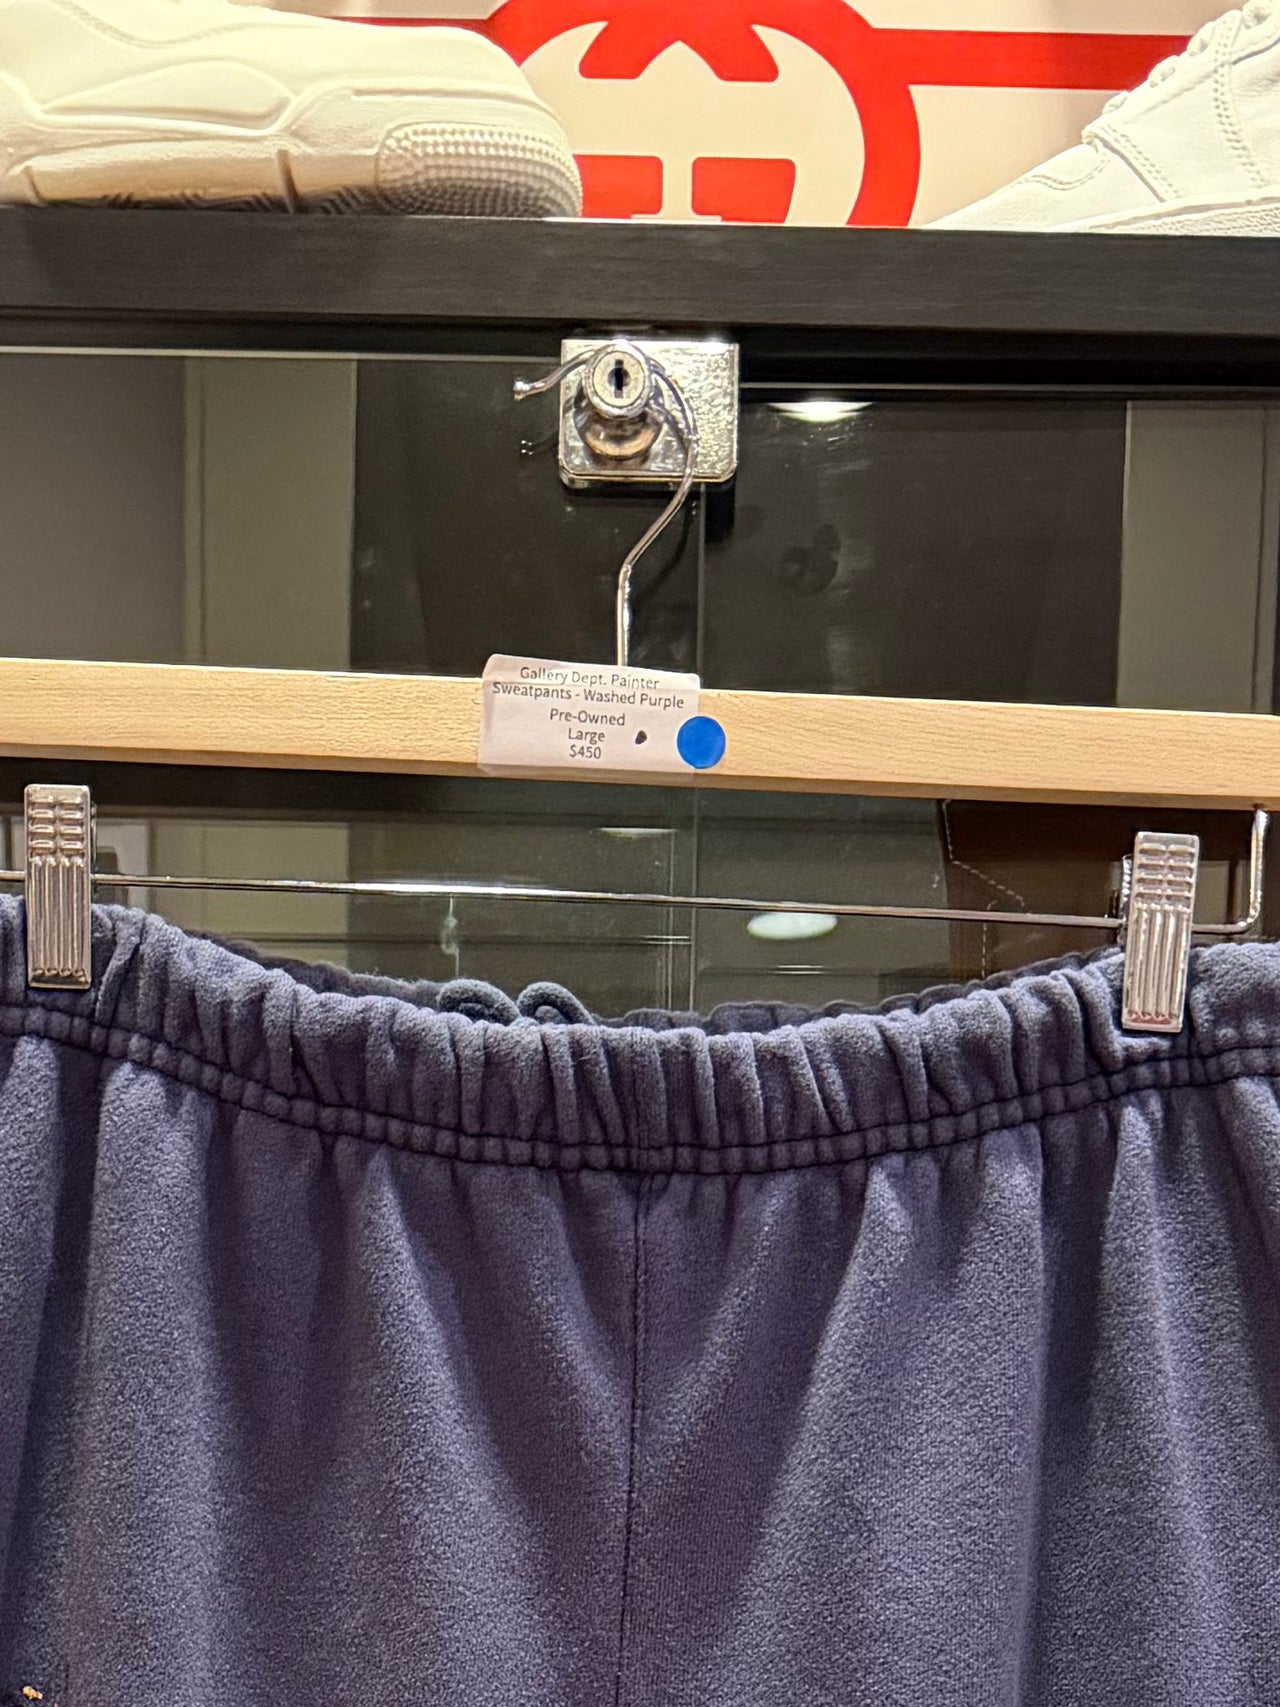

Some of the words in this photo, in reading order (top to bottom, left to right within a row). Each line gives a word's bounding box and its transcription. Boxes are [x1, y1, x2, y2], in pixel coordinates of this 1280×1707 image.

[520, 666, 568, 685] Gallery
[571, 671, 607, 687] Dept.
[611, 673, 660, 690] Painter
[492, 682, 572, 700] Sweatpants
[584, 689, 636, 706] Washed
[640, 695, 685, 712] Purple
[550, 708, 626, 726] Pre-Owned
[568, 728, 606, 745] Large
[569, 745, 602, 760] $450
